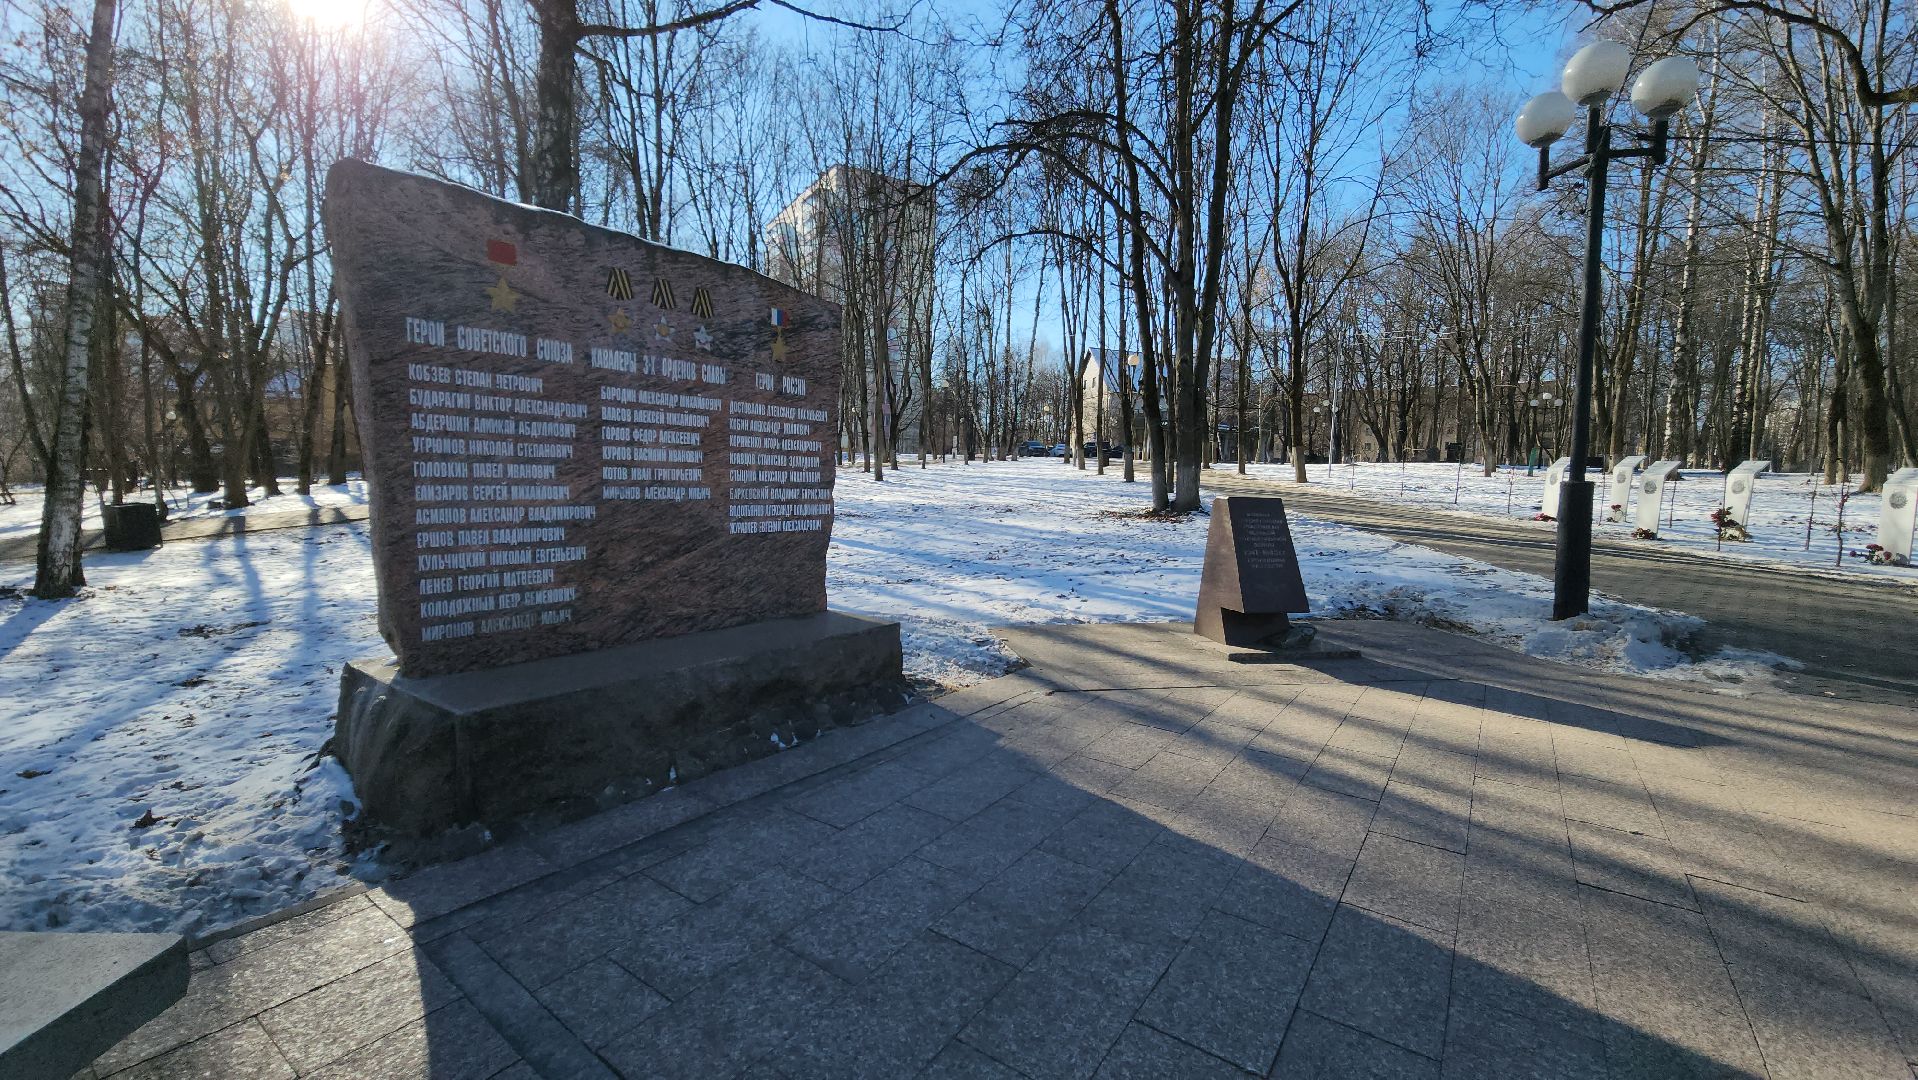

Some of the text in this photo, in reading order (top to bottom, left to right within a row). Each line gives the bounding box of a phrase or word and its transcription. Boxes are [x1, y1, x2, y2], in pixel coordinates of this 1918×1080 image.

[406, 317, 573, 364] ГЕРОИ СОВЕТСКОГО СОЮЗА
[592, 348, 636, 373] КАВАЛЕРЫ
[663, 358, 696, 381] ОРДЕНОВ
[702, 364, 726, 384] СЛАВЫ
[409, 363, 543, 393] КОБЗЕВ СТЕПАН ПЕТРОВИЧ
[783, 376, 806, 396] РОССИИ
[410, 389, 588, 419] БУДАРАГИН ВИКТОР АЛЕКСАНДРОВИЧ
[601, 386, 722, 411] БОРОДИН АЛЕКСАНДР МИХАЙЛОВИЧ
[411, 413, 469, 433] АБДЕРШИН
[602, 407, 710, 427] ВЛАСОВ АЛЕКСЕЙ МИХАЙЛОВИЧ
[602, 426, 700, 445] ГОРЛОВ ФЕДОР АЛЕКСЕЕВИЧ
[413, 437, 573, 459] УГРЮМОВ НИКОЛАЙ СТЕПАНОВИЧ
[602, 446, 703, 463] КУРЛОВ ВАСИЛИЙ ИВАНОВИЧ
[414, 461, 555, 479] ГОЛОВКИН ПАВЕЛ ИВАНОВИЧ
[603, 467, 702, 481] КОТОВ ИВАН ГРИГОРЬЕВИЧ
[415, 481, 570, 501] ЕЛИЗАРОВ СЕРГЕЙ МИХАЙЛОВИЧ
[603, 486, 711, 502] МИРОНОВ АЛЕКСАНДР ИЛЬИЧ
[416, 506, 596, 525] АСМАНОВ АЛЕКСАНДР ВЛАДИМИРОВИЧ
[417, 527, 565, 548] ЕРШОВ ПАВЕЛ ВЛАДИМИРОВИЧ
[418, 546, 587, 571] КУЛЬЧИЦКИЙ НИКОЛАЙ ЕВГЕНЬЕВИЧ
[458, 570, 499, 590] ГЕОРГИЙ
[504, 569, 554, 587] МАТВЕЕВИЧ
[422, 621, 474, 642] МИРОНОВ
